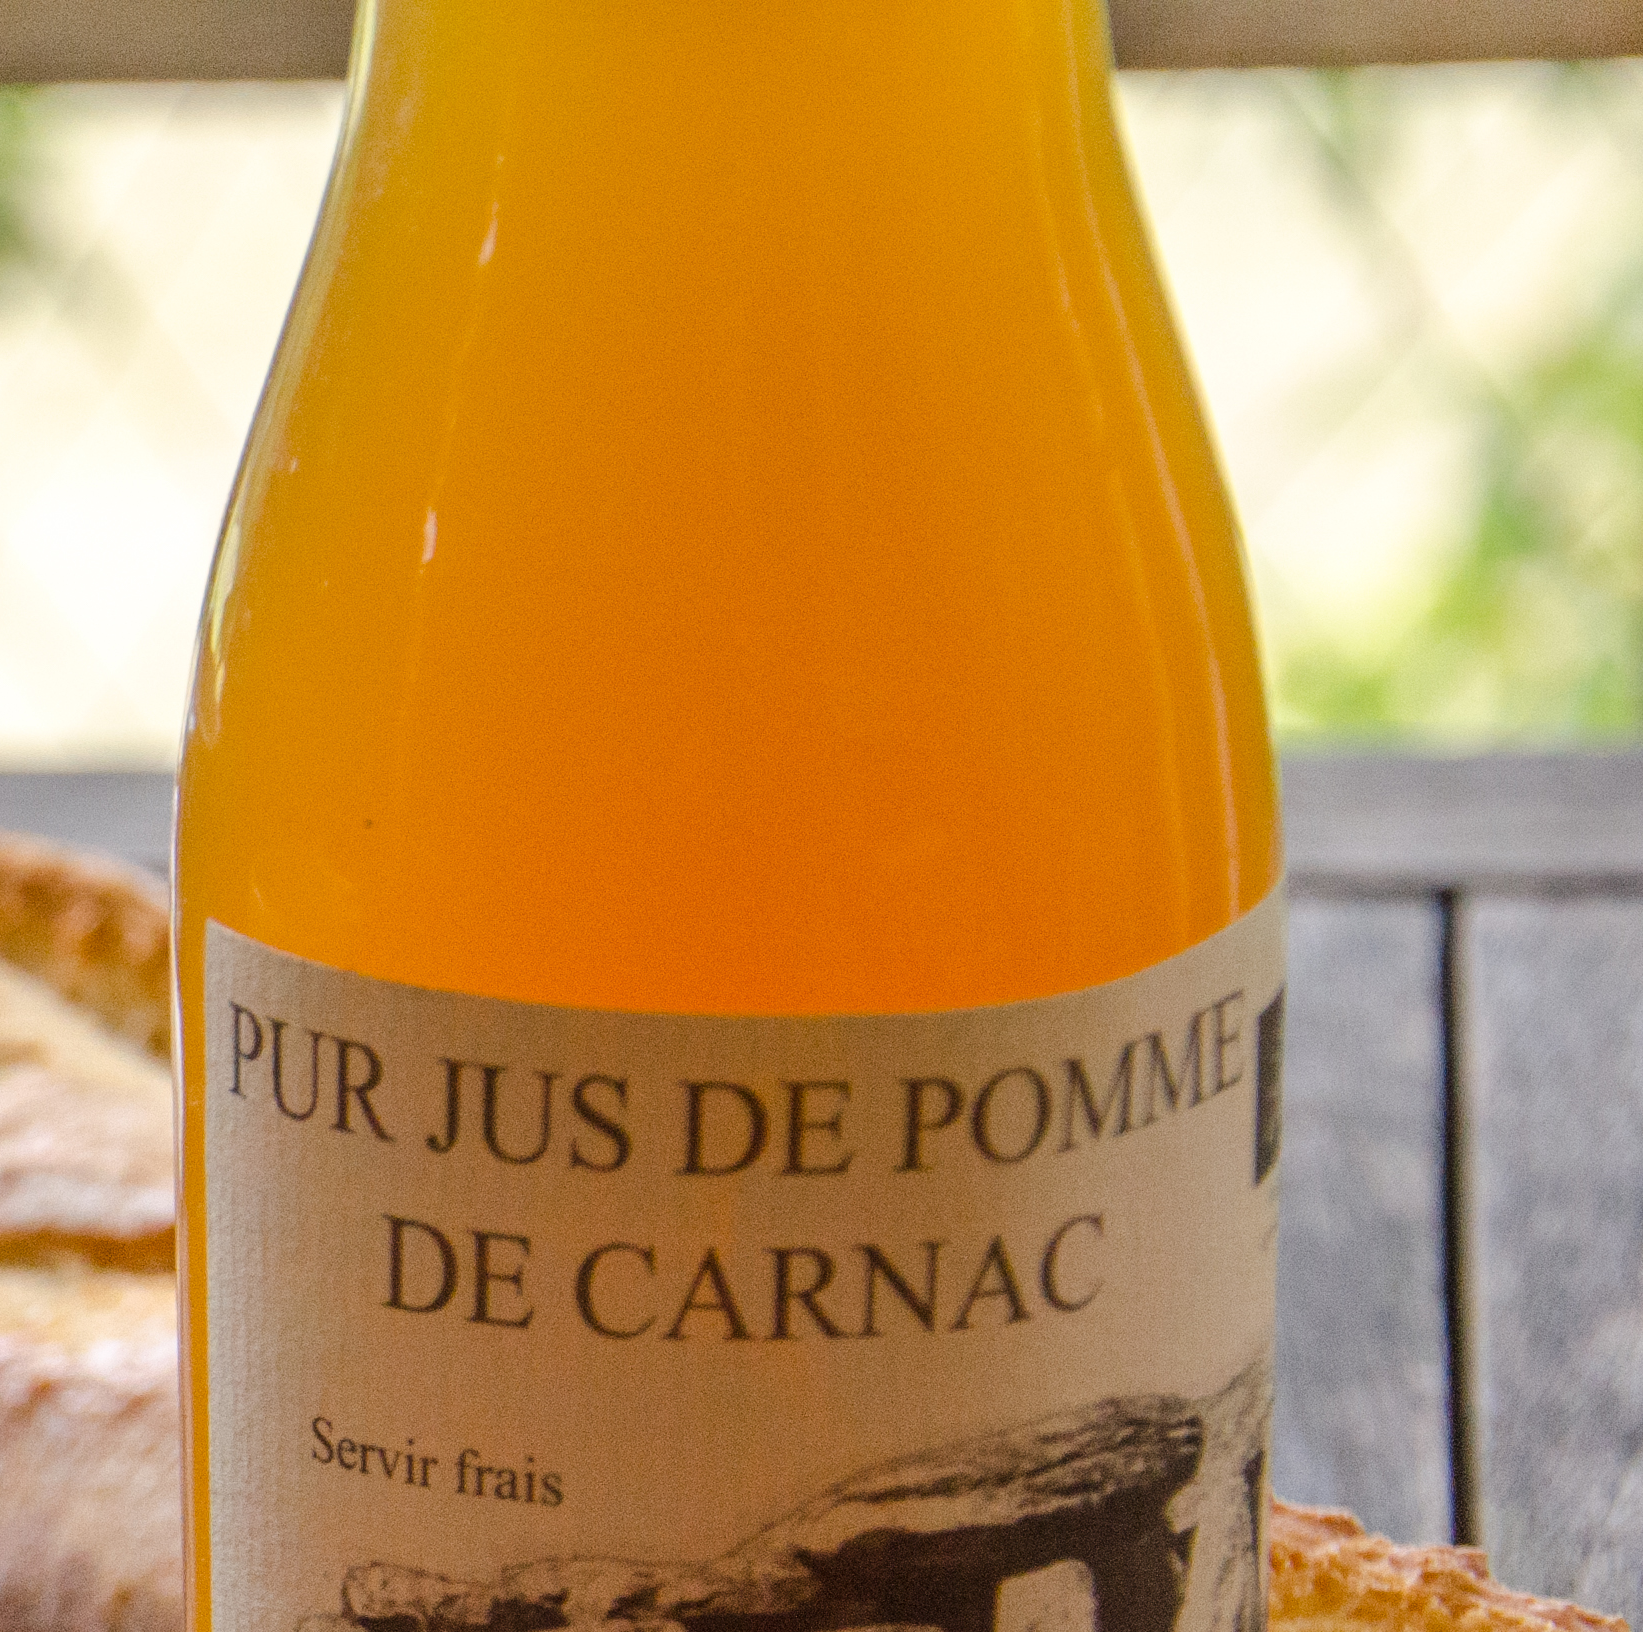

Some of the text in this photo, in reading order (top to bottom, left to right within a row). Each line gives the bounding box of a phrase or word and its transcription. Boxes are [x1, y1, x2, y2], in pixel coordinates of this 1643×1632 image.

[229, 988, 1246, 1178] PUR JUS DE POMME
[381, 1213, 1108, 1343] DE CARNAC
[311, 1416, 564, 1507] Servir frais
